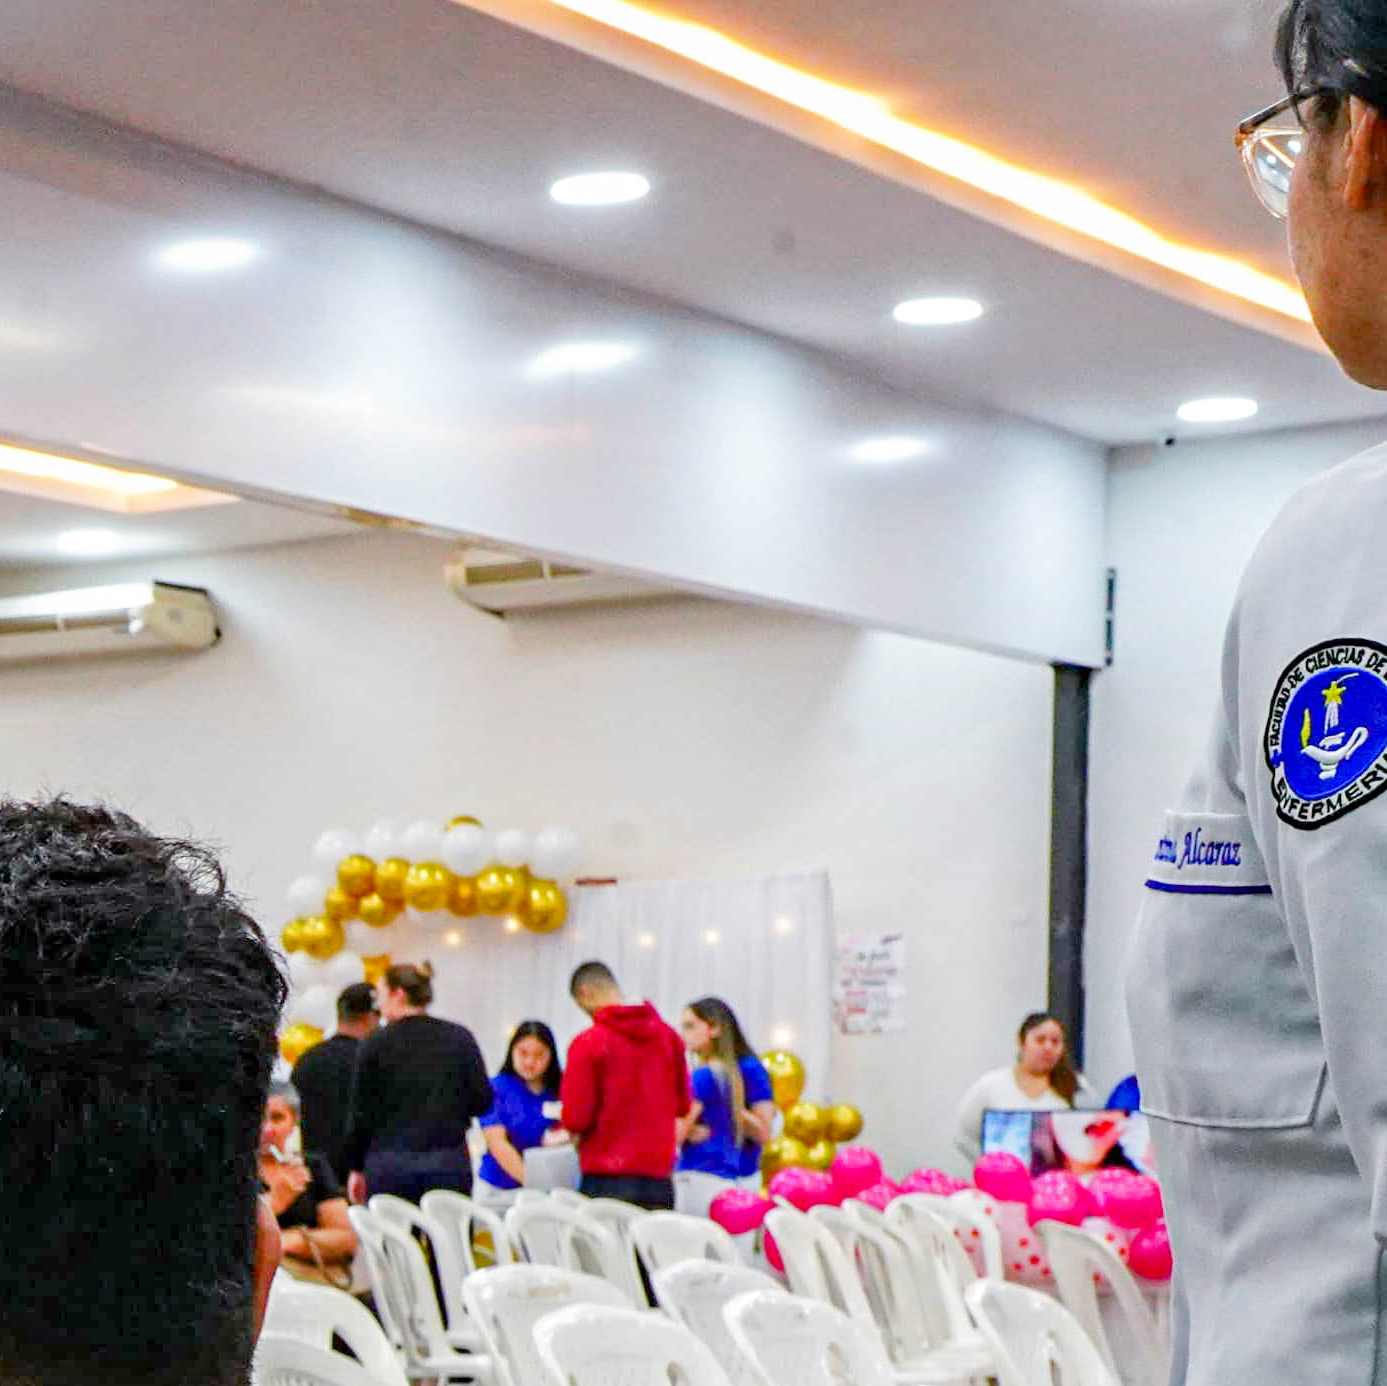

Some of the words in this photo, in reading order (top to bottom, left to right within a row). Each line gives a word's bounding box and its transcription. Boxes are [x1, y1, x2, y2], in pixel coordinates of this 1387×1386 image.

[1269, 688, 1291, 747] FACULTAD
[1288, 668, 1305, 689] DE
[1305, 648, 1365, 674] CIENCIAS
[1277, 753, 1387, 820] ENFERMERI
[1177, 827, 1241, 869] Alcaraz
